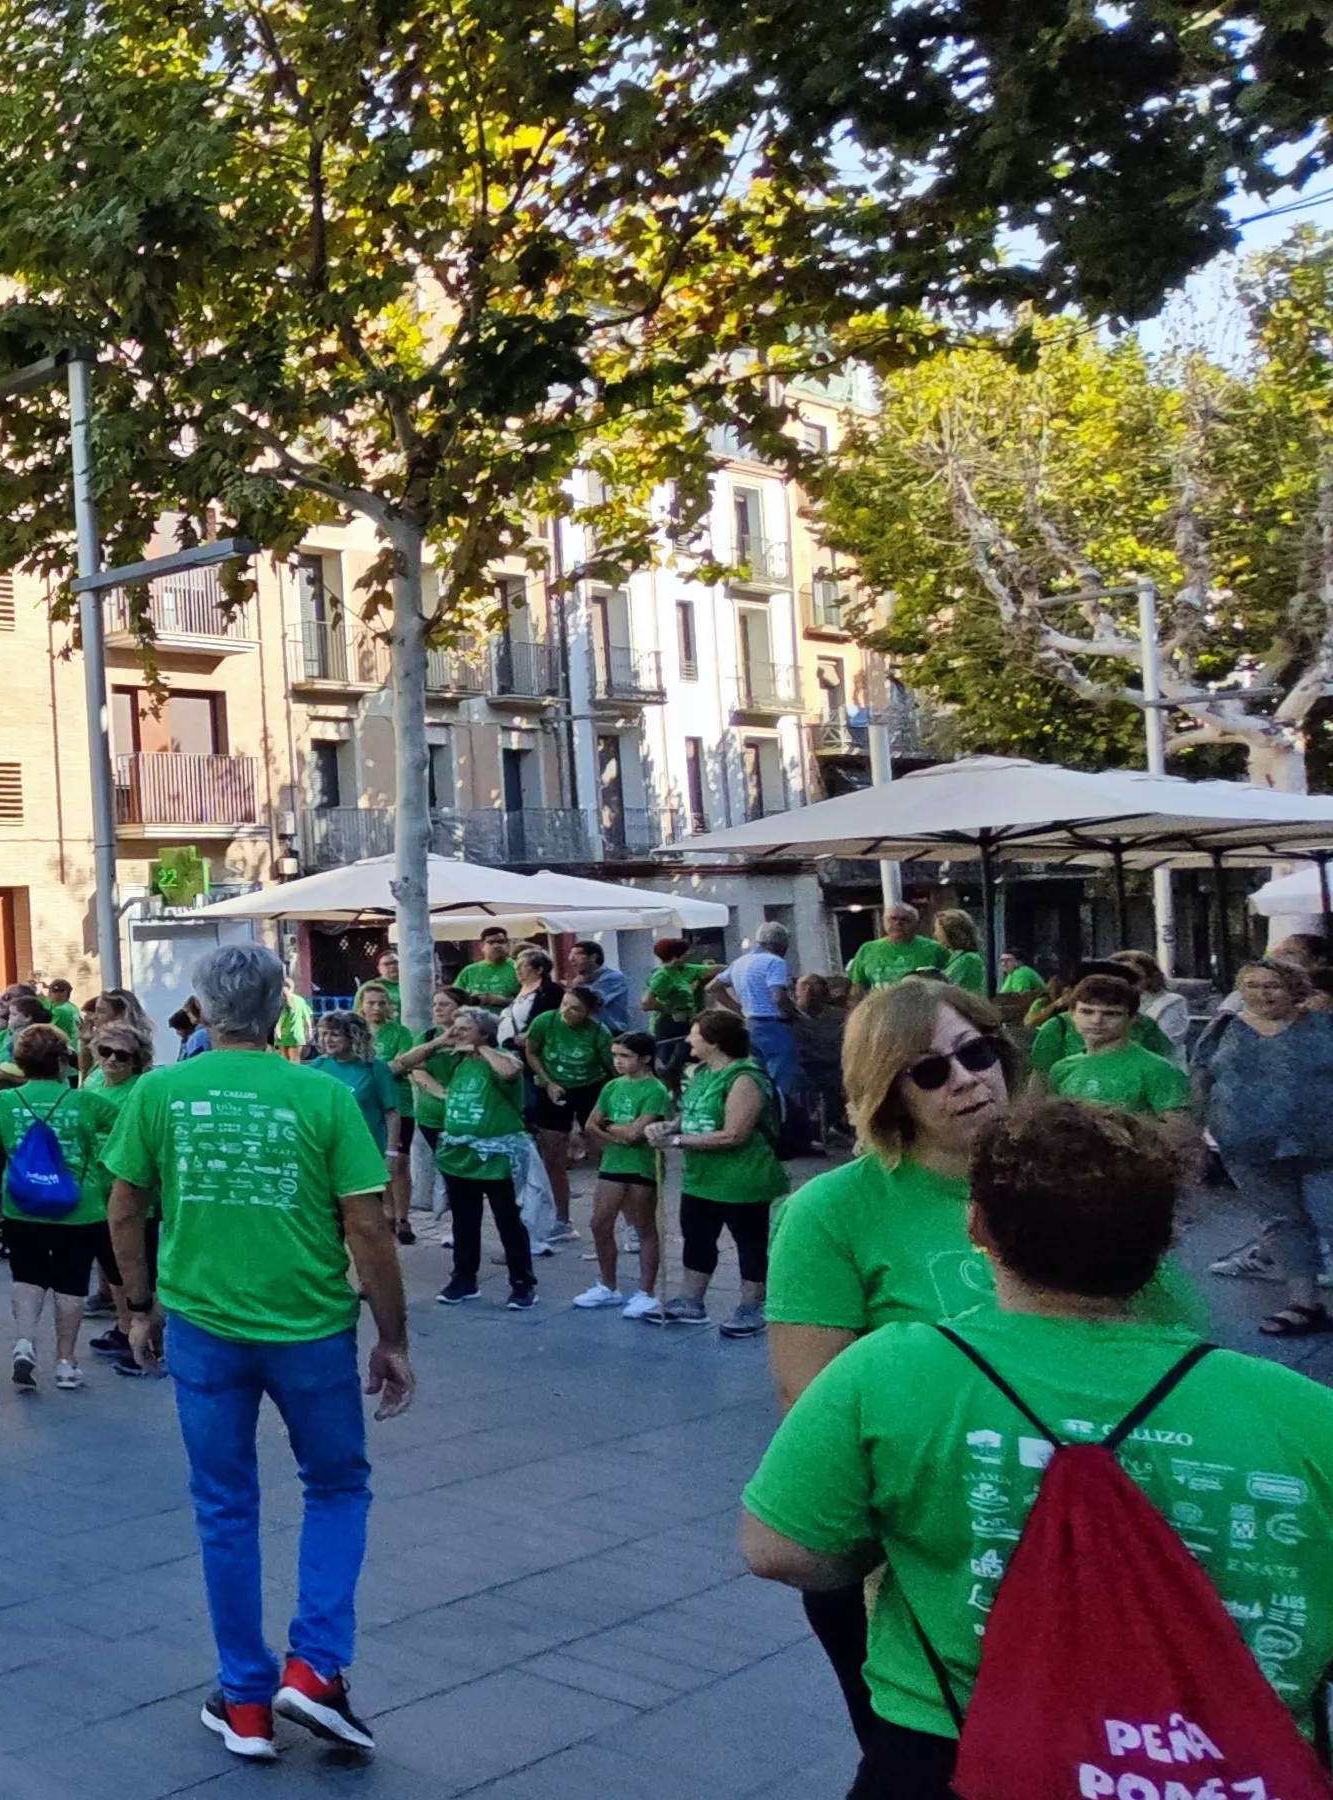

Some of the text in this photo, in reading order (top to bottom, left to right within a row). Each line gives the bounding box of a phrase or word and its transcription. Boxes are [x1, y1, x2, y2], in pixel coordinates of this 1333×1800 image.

[158, 868, 178, 888] 22
[1101, 1423, 1194, 1446] CLLIZO
[1104, 1712, 1225, 1764] PEÑA
